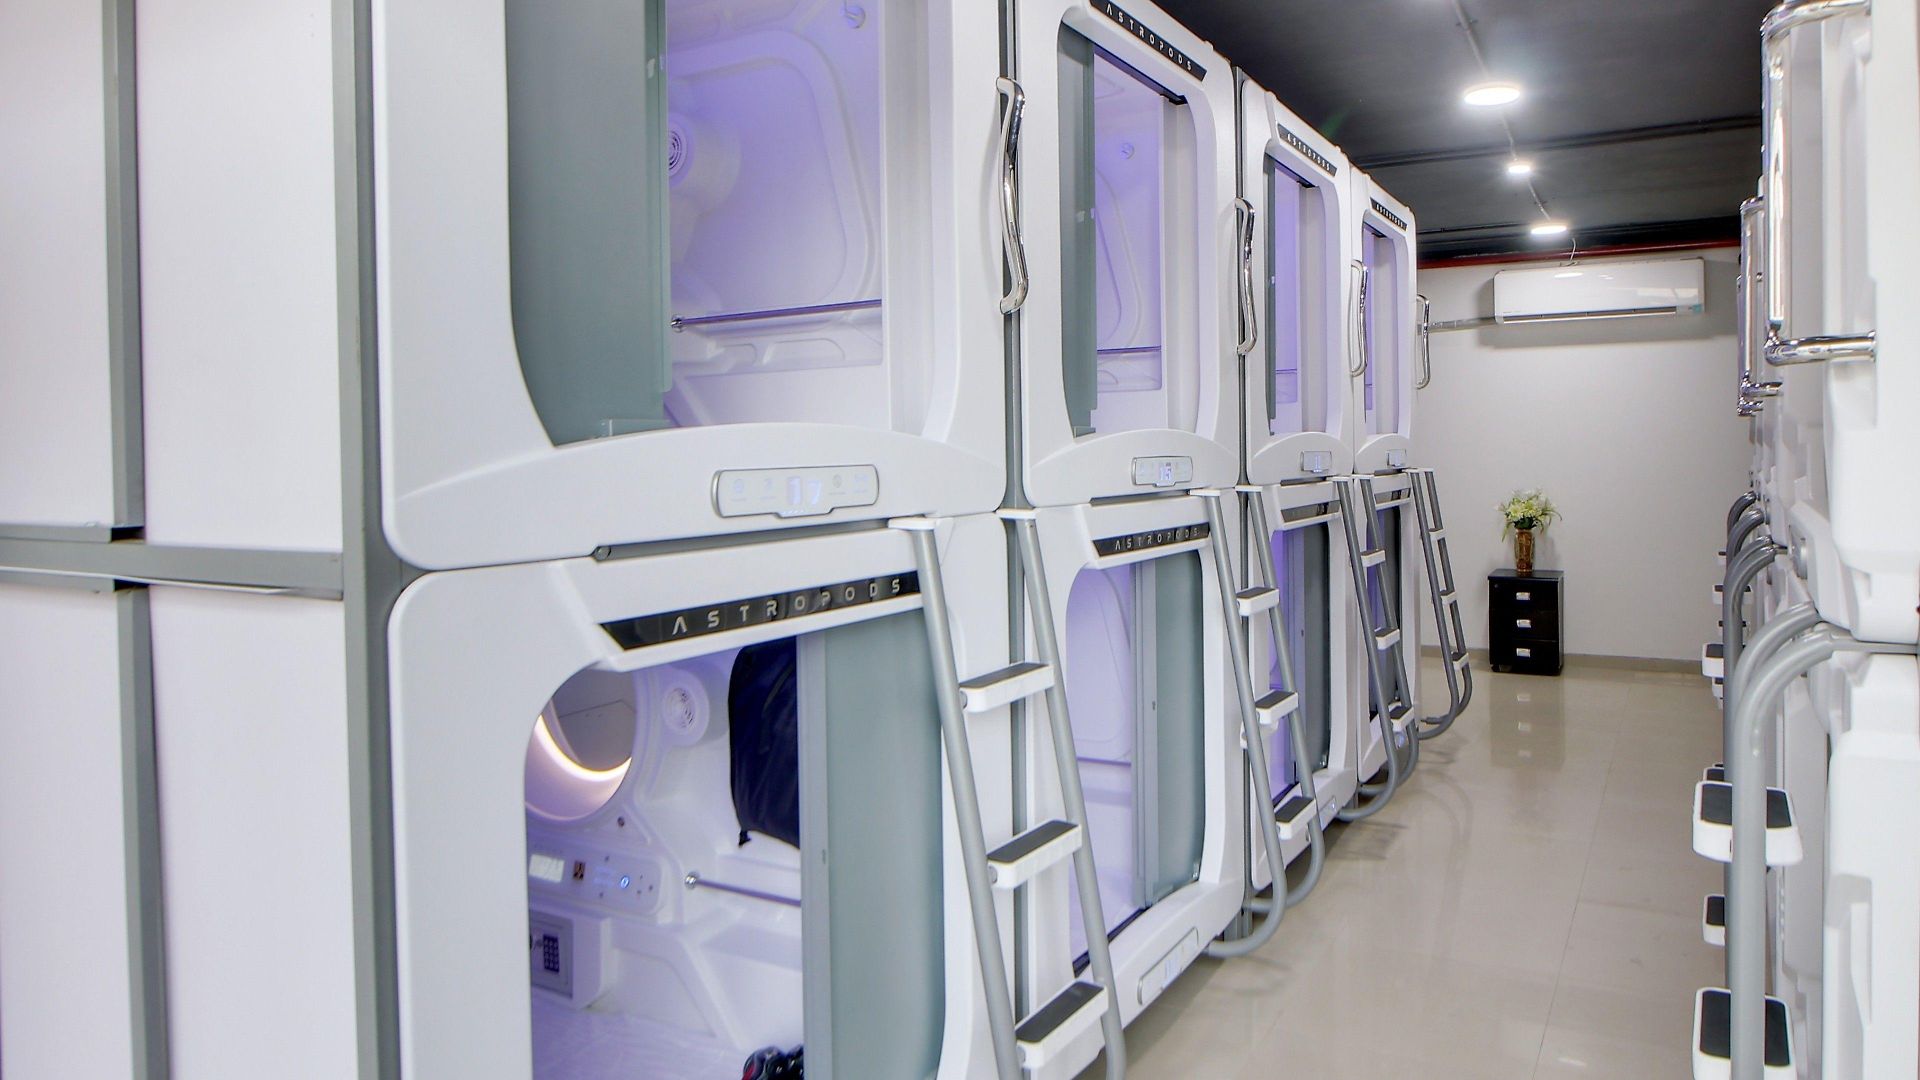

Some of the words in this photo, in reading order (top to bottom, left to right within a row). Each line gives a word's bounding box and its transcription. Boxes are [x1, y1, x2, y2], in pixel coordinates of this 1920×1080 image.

[1106, 3, 1192, 71] ASTROPODS
[787, 477, 822, 506] 17
[1115, 527, 1200, 550] ASTROPODS
[672, 578, 900, 635] ASTROPODS
